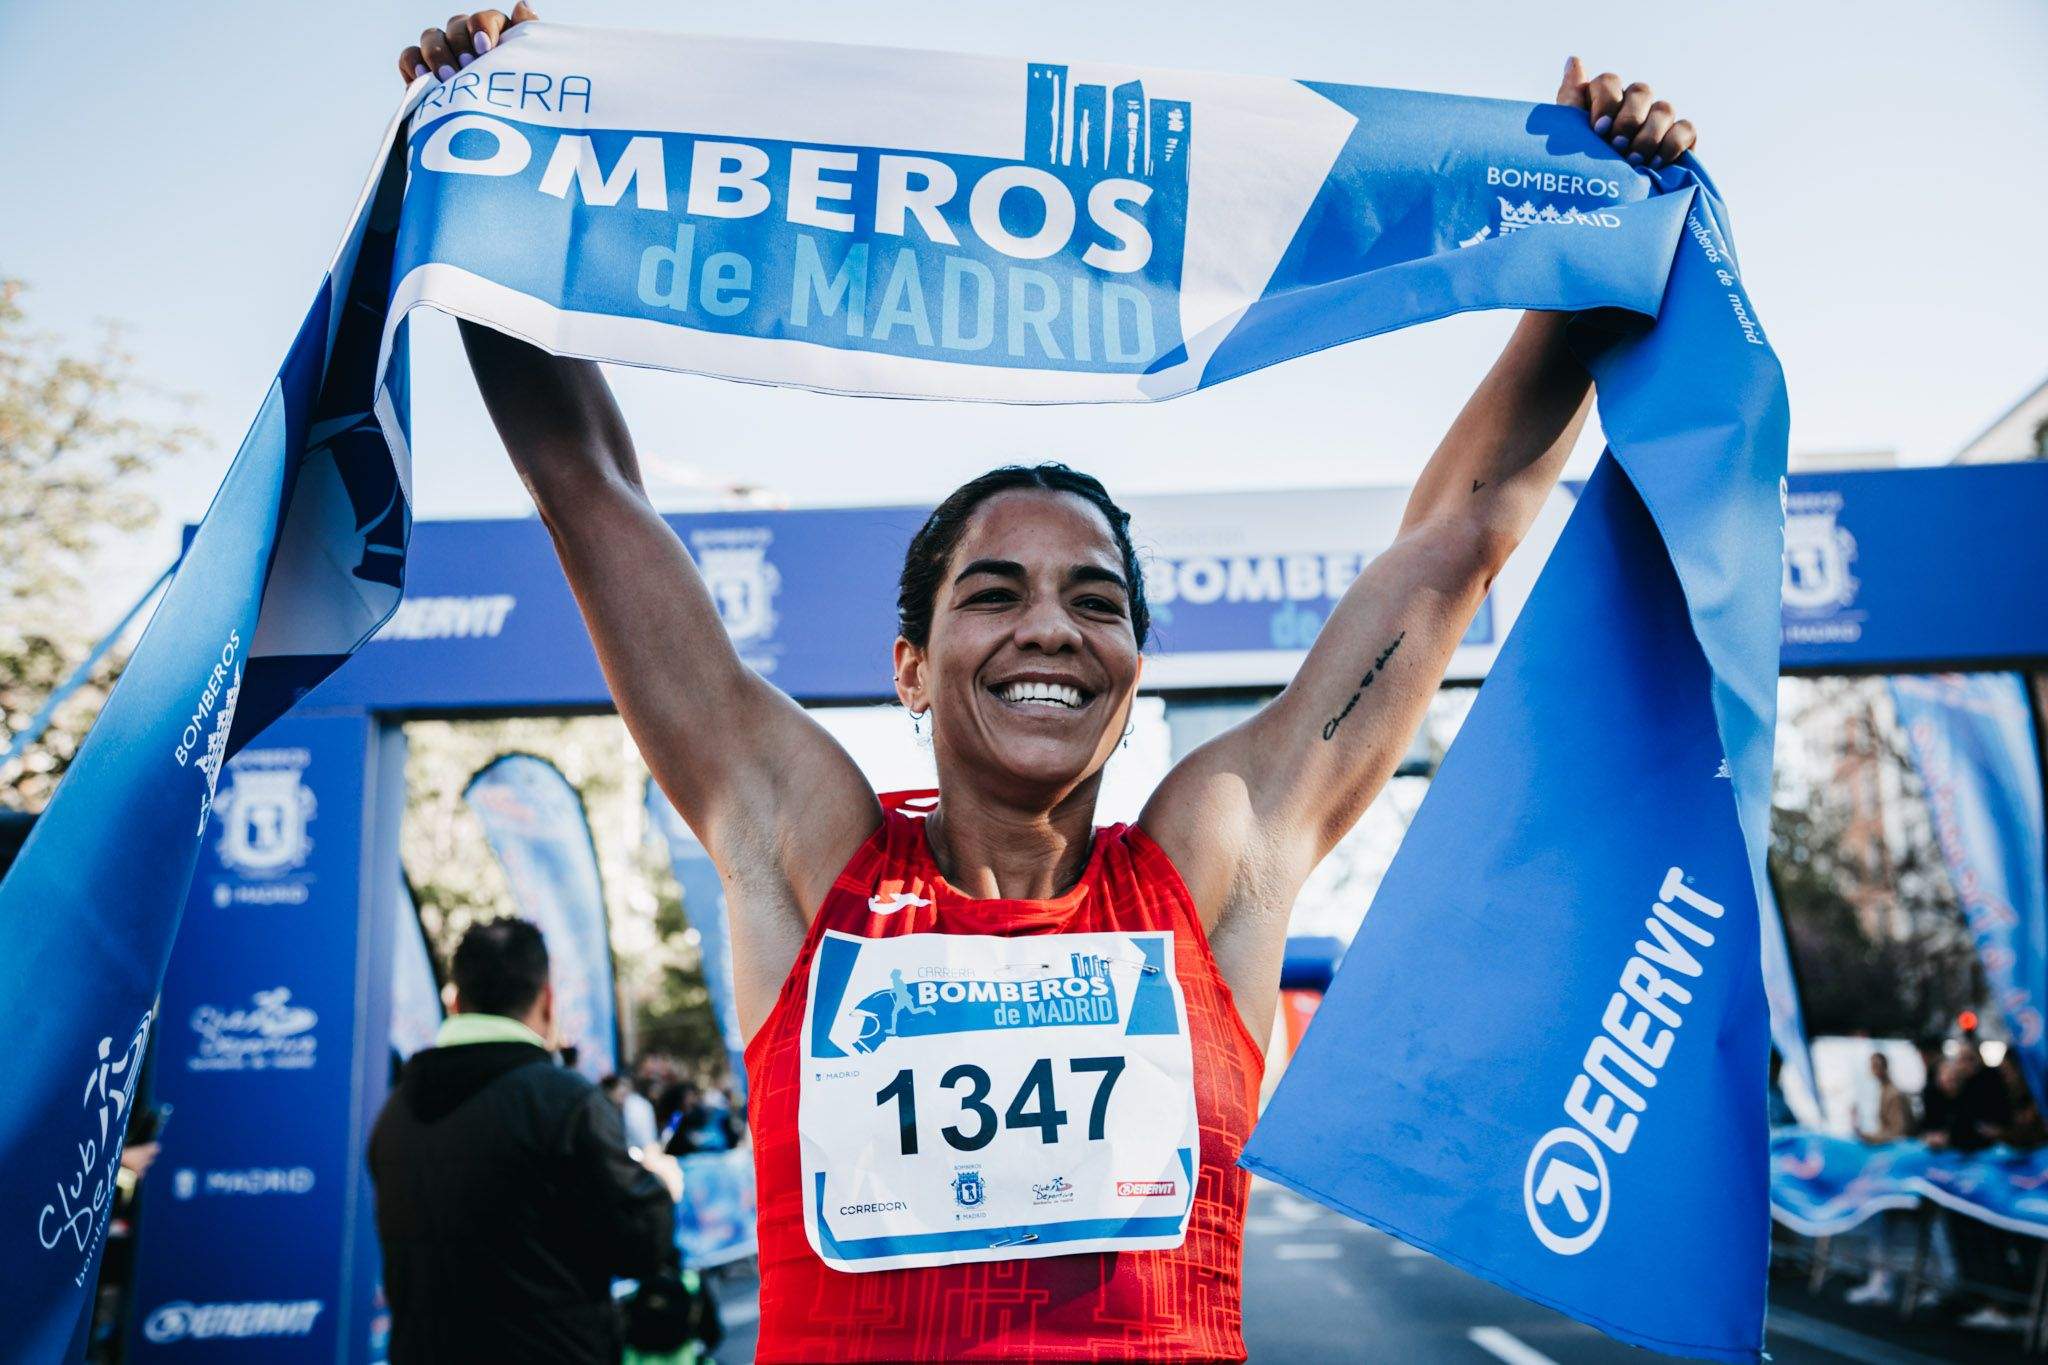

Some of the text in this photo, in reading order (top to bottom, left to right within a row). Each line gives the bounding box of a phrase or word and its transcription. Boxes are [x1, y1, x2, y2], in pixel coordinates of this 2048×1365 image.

[414, 72, 592, 120] RRERA
[420, 114, 1154, 274] OMBEROS
[1486, 166, 1620, 199] BOMBEROS
[637, 223, 1157, 365] de MADRID
[1716, 269, 1734, 287] de
[1728, 293, 1764, 345] madrid
[1144, 557, 1362, 606] BOMBE
[174, 629, 240, 768] BOMBEROS
[917, 966, 976, 978] CARRERA
[918, 976, 1110, 1006] BOMBEROS
[994, 997, 1115, 1026] de MADRID
[1563, 866, 1726, 1156] ENERVIT
[826, 1070, 860, 1081] MADRID
[876, 1056, 1126, 1156] 1347
[38, 1138, 97, 1250] Club
